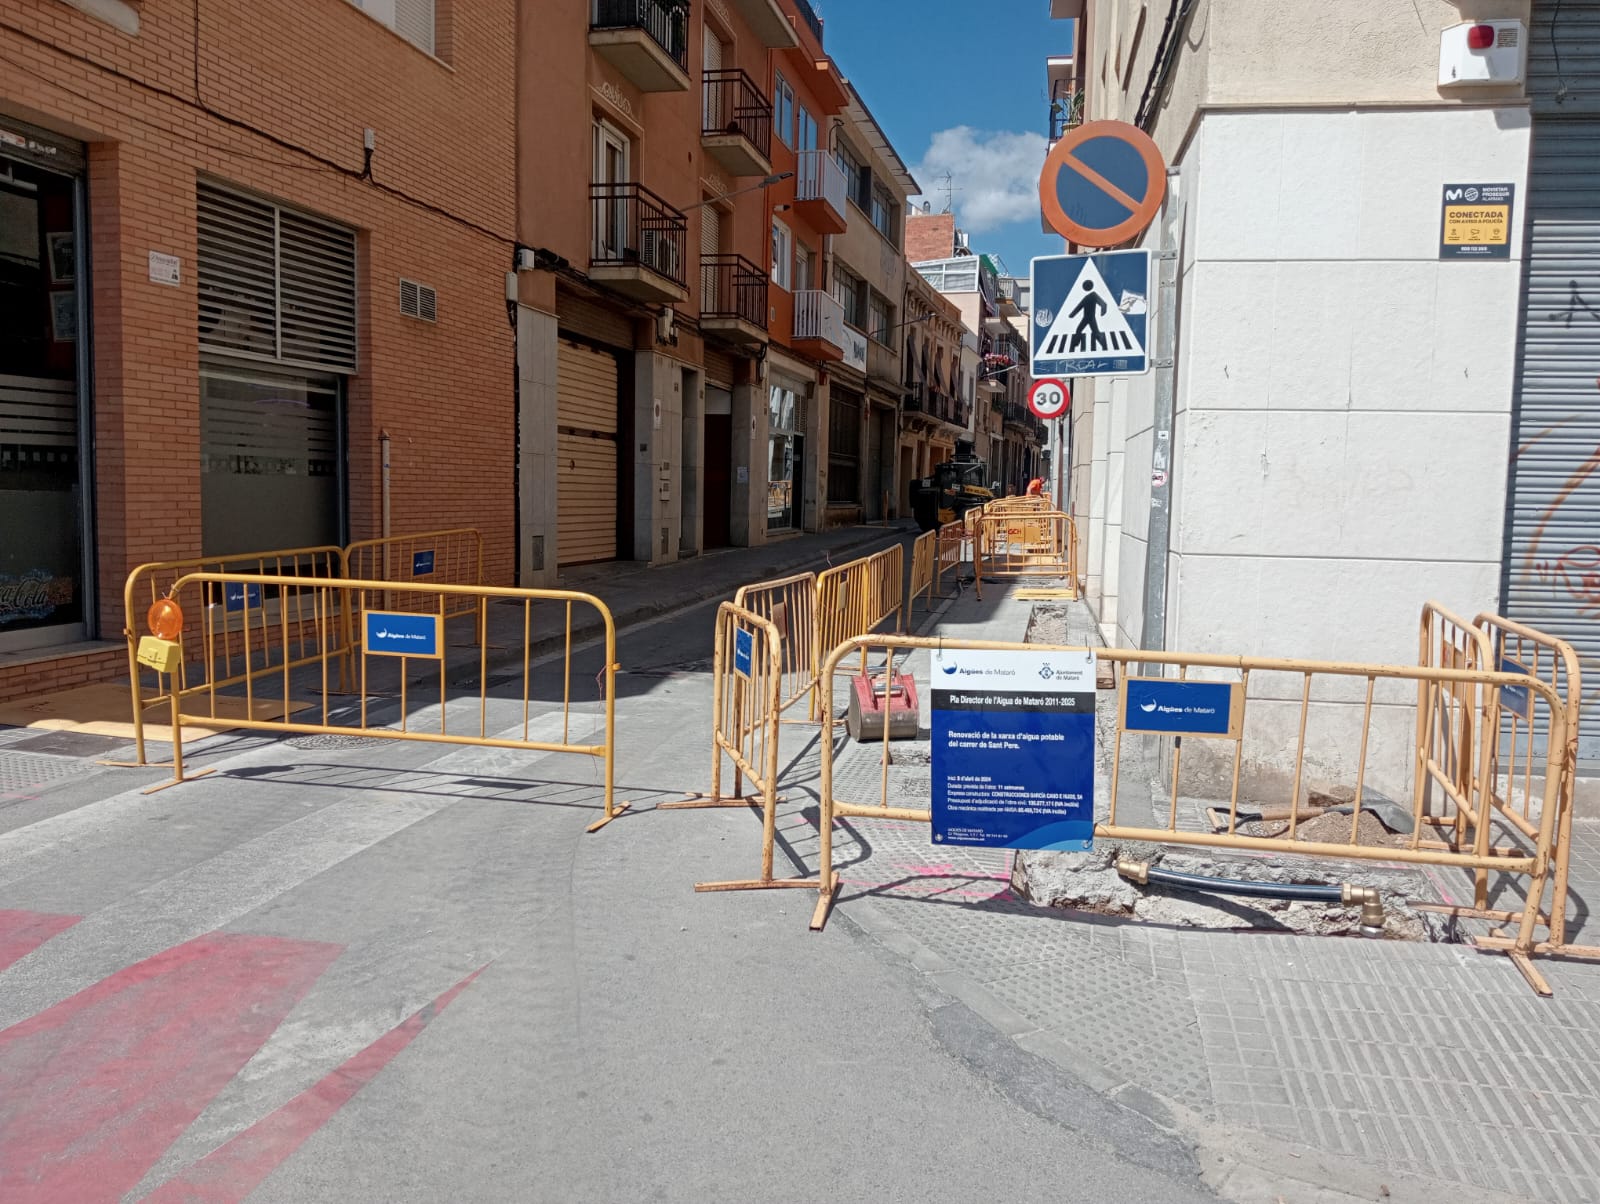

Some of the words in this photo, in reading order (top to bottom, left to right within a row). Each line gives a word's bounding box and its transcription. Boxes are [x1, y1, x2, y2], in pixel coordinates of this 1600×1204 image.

[1449, 211, 1504, 219] CONECTADA
[1036, 392, 1061, 406] 30
[959, 667, 983, 676] Aigües
[993, 668, 1016, 676] Mataró
[950, 695, 959, 704] Pla
[960, 695, 984, 705] Director
[984, 696, 993, 705] de
[993, 696, 1013, 707] l'Aigua
[1014, 697, 1022, 705] de
[1023, 697, 1044, 706] Mataró
[1044, 697, 1076, 706] 2011-2025
[1157, 705, 1183, 714] Aigües
[948, 730, 980, 739] Renovació
[981, 731, 990, 739] de
[1016, 732, 1039, 742] d'aigua
[1040, 733, 1065, 742] potable
[988, 741, 1002, 749] Sant
